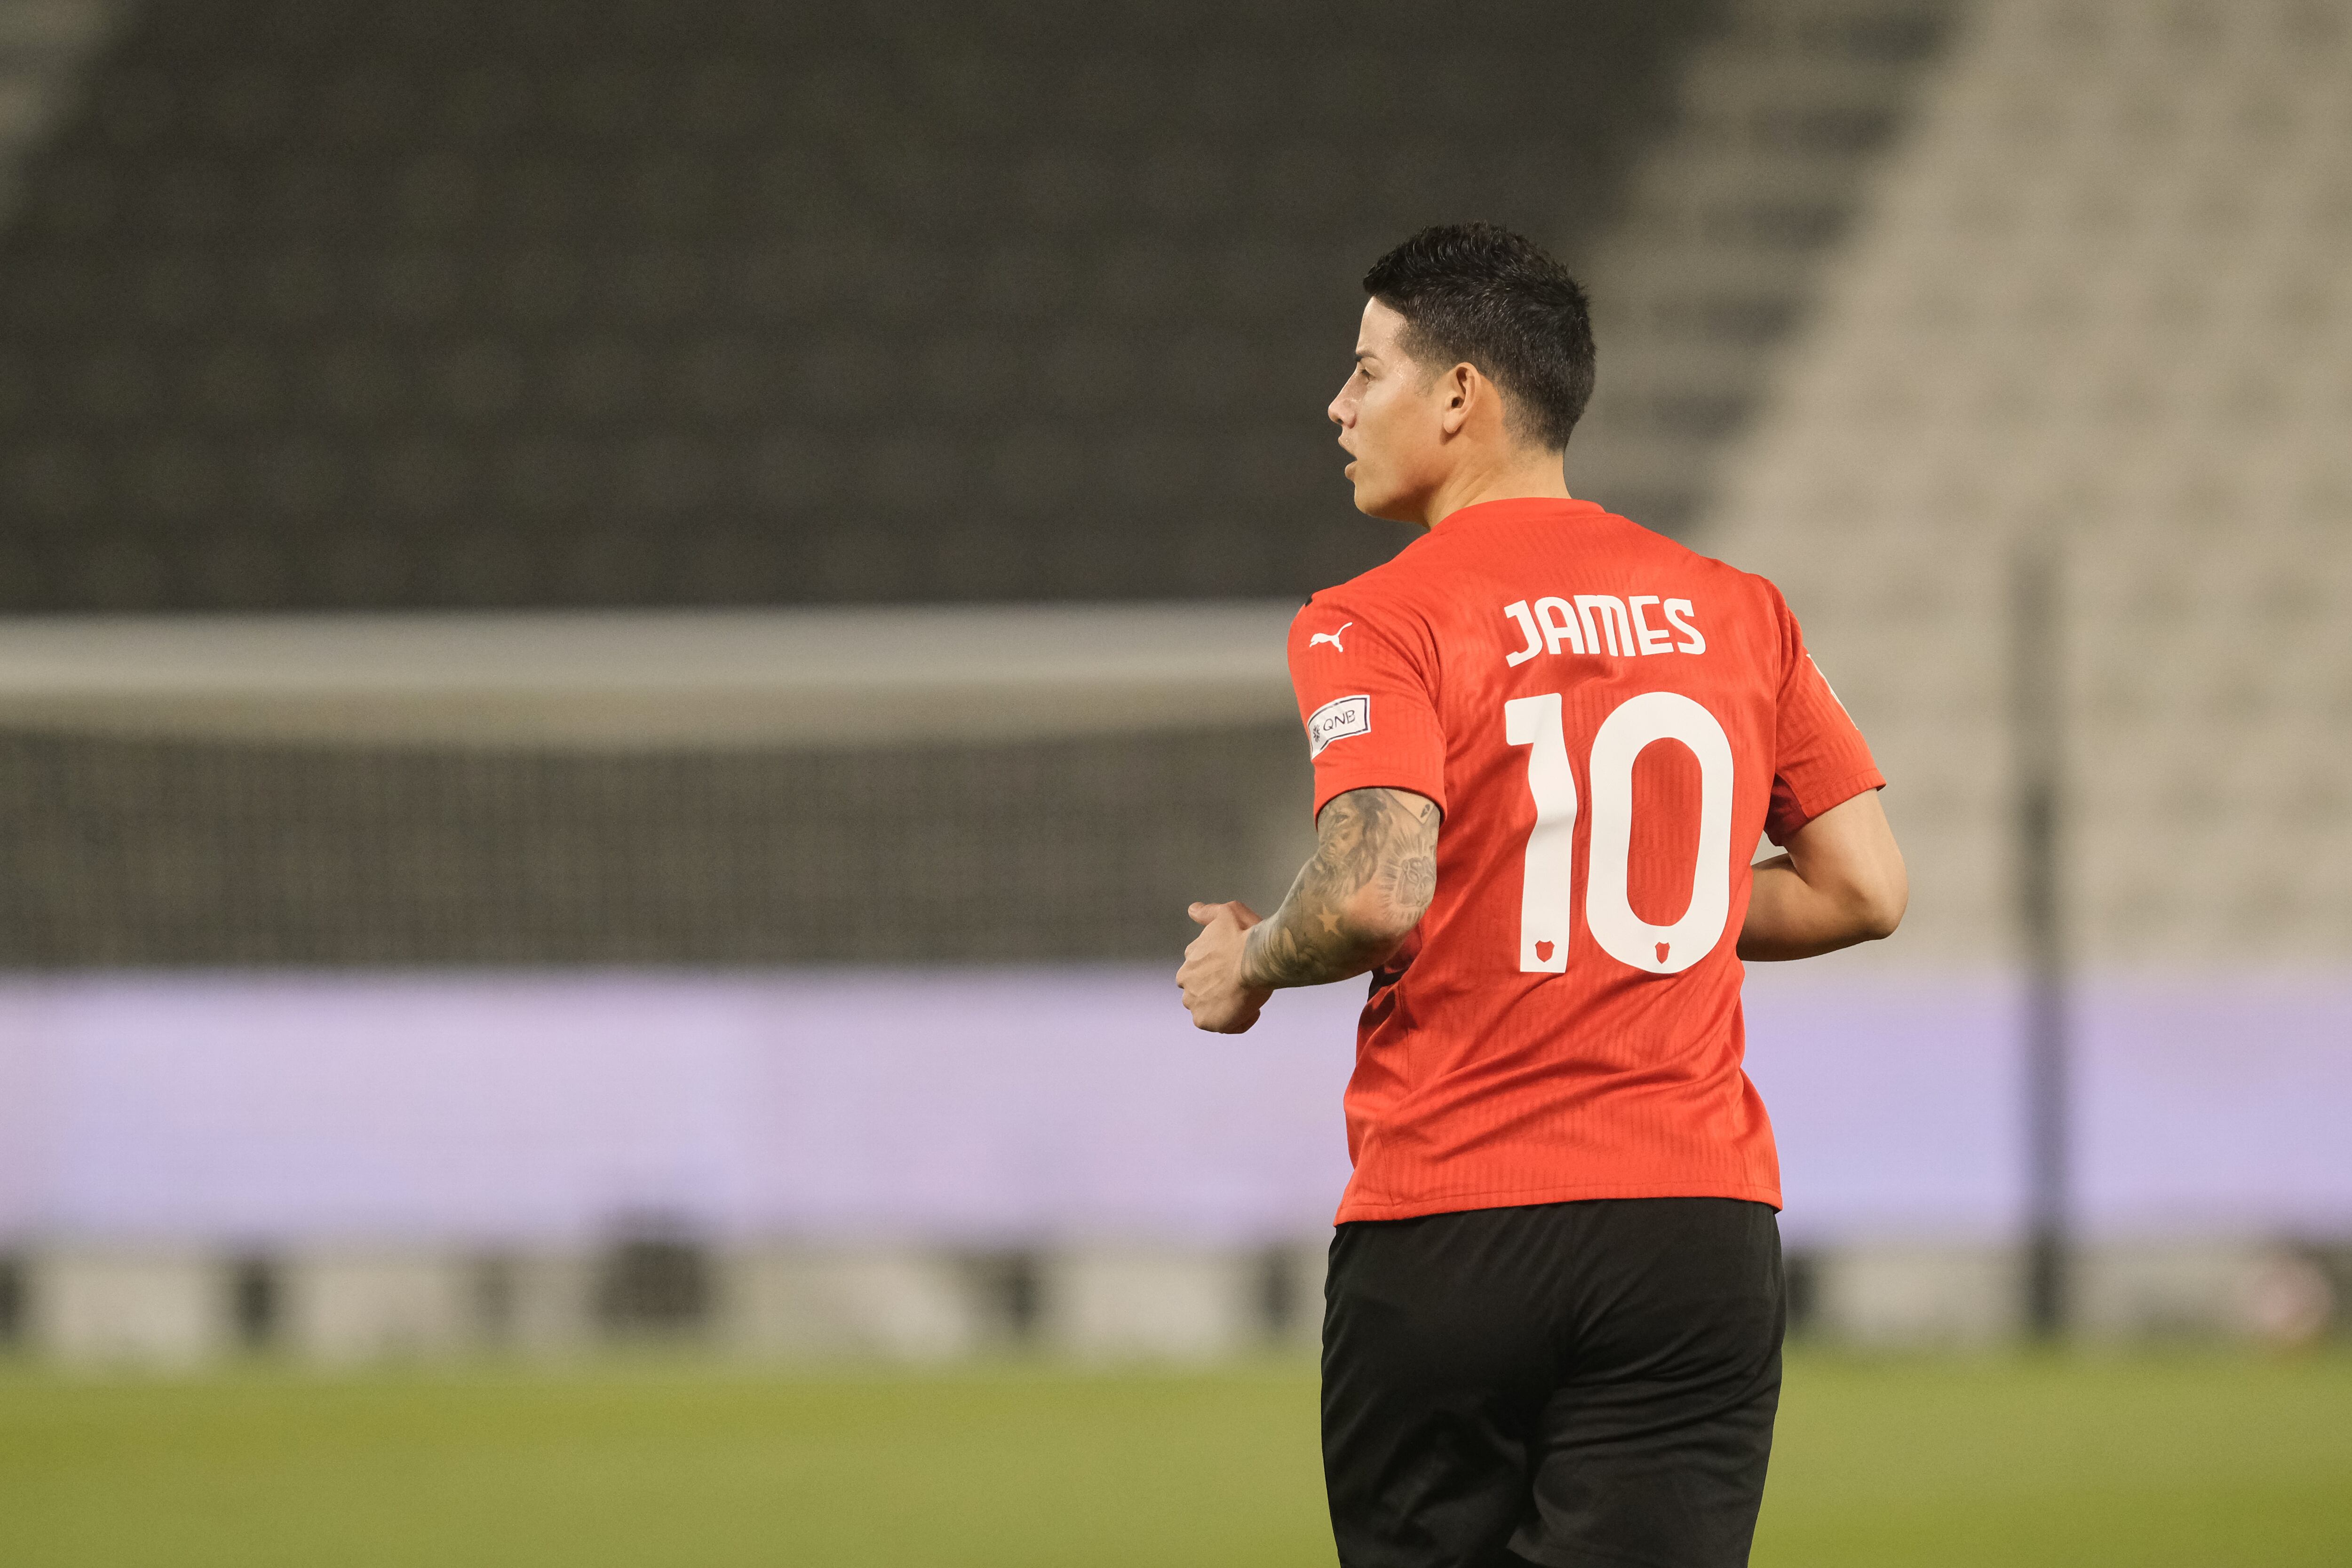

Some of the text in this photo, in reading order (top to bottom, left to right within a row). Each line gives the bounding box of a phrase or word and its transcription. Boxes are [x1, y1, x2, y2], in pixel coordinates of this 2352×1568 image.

[1504, 594, 1706, 668] JAMES
[1323, 710, 1356, 730] QNB
[1504, 691, 1734, 974] 10
